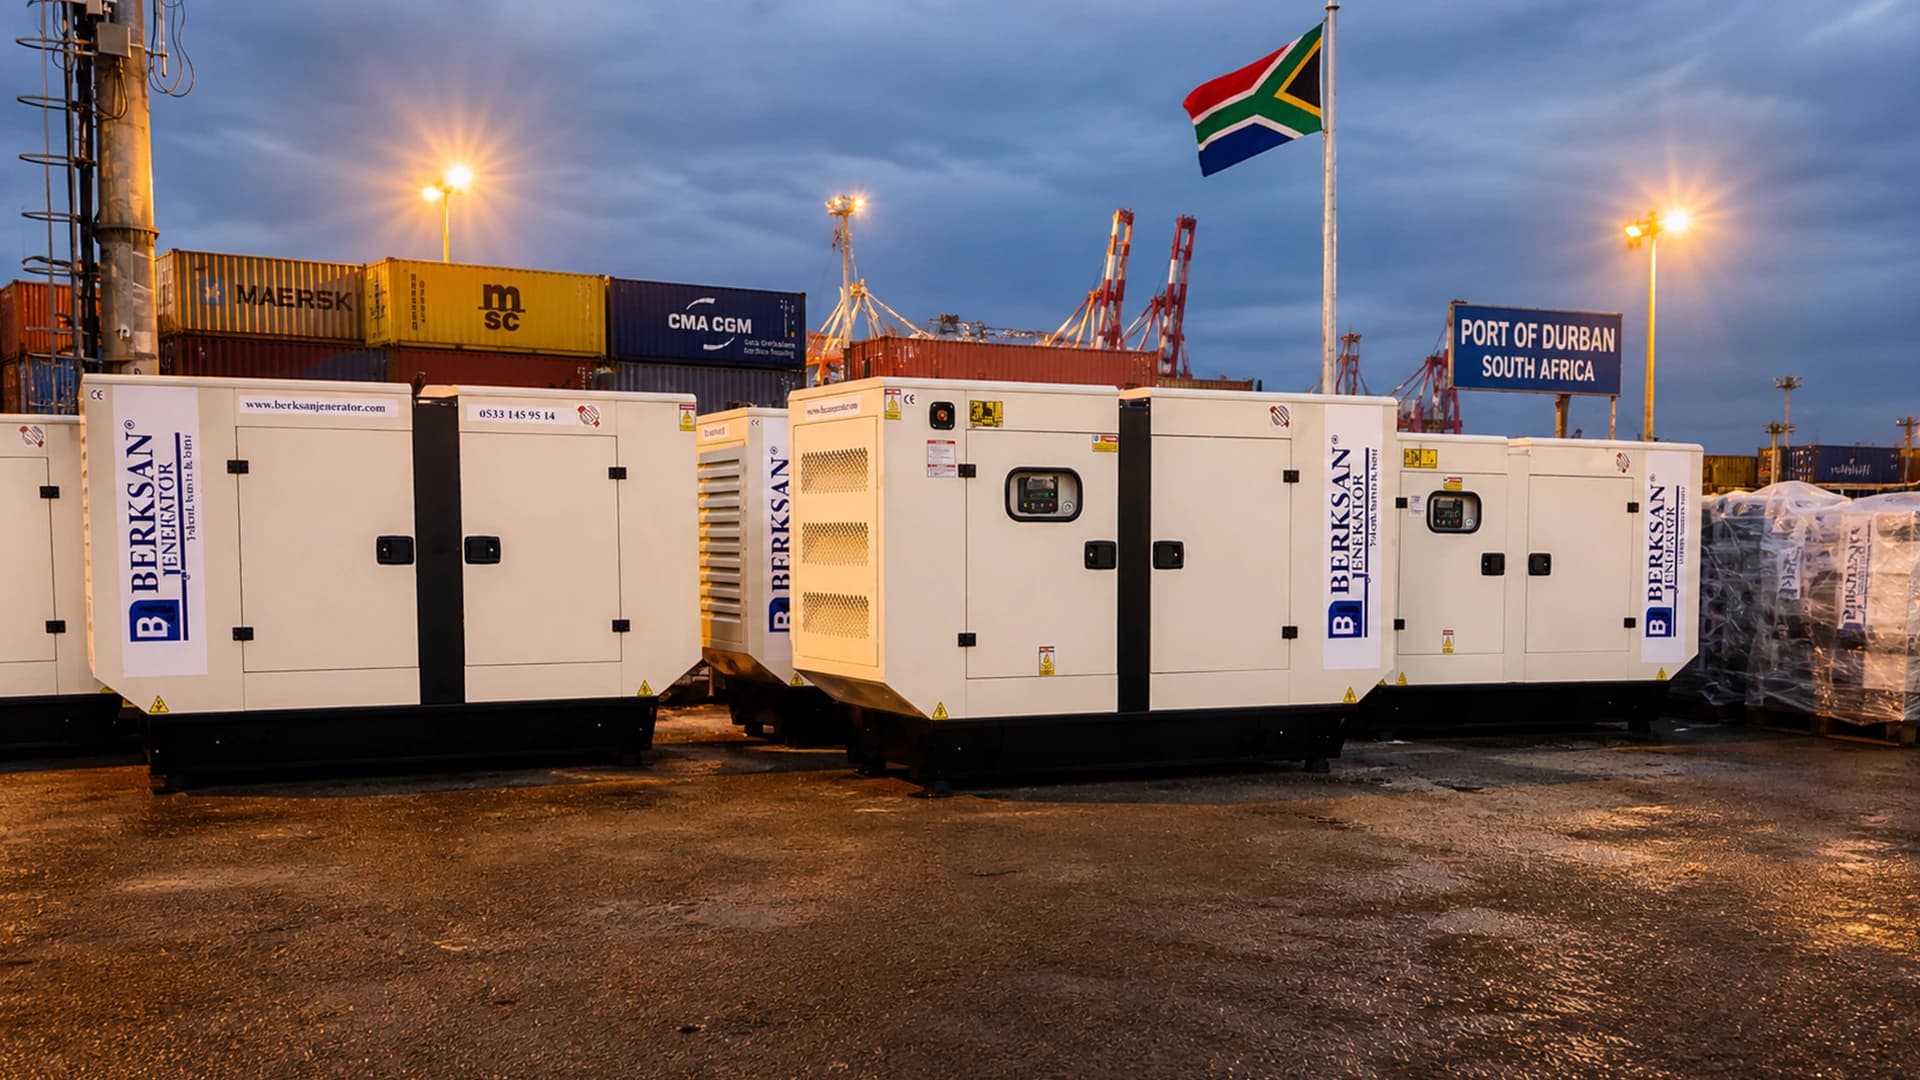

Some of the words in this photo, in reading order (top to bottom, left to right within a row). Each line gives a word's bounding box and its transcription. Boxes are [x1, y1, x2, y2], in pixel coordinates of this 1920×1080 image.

[236, 284, 353, 312] MAERSK
[667, 312, 709, 332] CMA
[712, 315, 753, 335] CGM
[1460, 318, 1510, 347] PORT
[1513, 321, 1538, 349] OF
[1542, 323, 1616, 353] DURBAN
[1482, 354, 1536, 380] SOUTH
[1539, 357, 1596, 382] AFRICA
[245, 399, 386, 414] www.berksanjenerator.com
[479, 408, 505, 419] 0533
[508, 409, 526, 420] 145
[528, 410, 541, 421] 95
[544, 411, 556, 421] 14
[125, 431, 160, 595] BERKSAN
[1331, 447, 1351, 595] BERKSAN
[1648, 484, 1666, 602] BERKSAN
